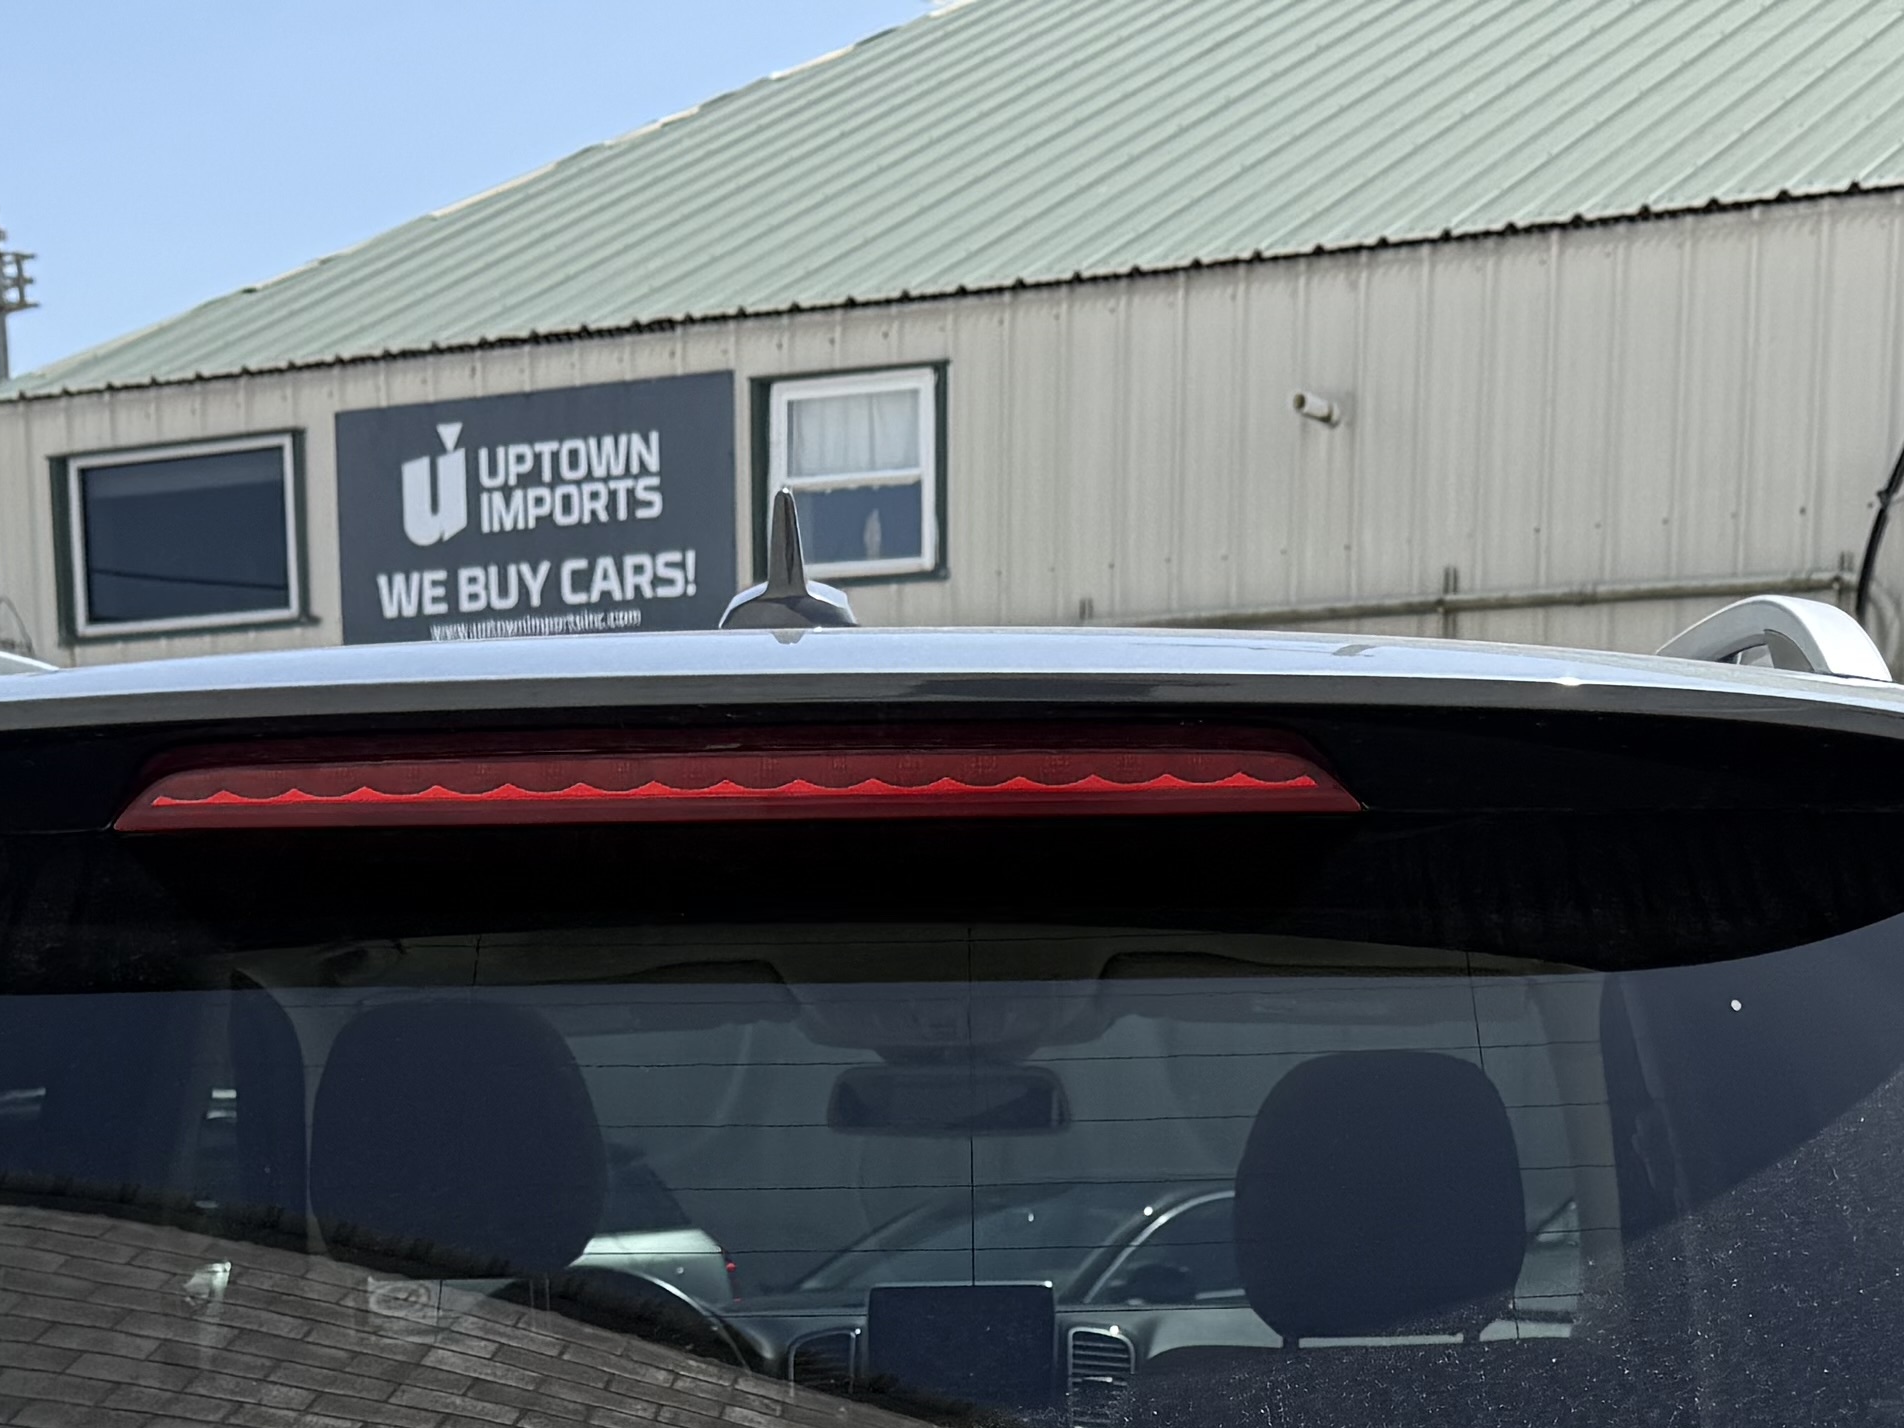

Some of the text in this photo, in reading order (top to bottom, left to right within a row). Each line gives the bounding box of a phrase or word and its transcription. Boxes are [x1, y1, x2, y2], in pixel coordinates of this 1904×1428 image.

[478, 430, 660, 488] UPTOWN
[479, 476, 663, 534] IMPORTS
[377, 549, 698, 619] WE BUY CARS!
